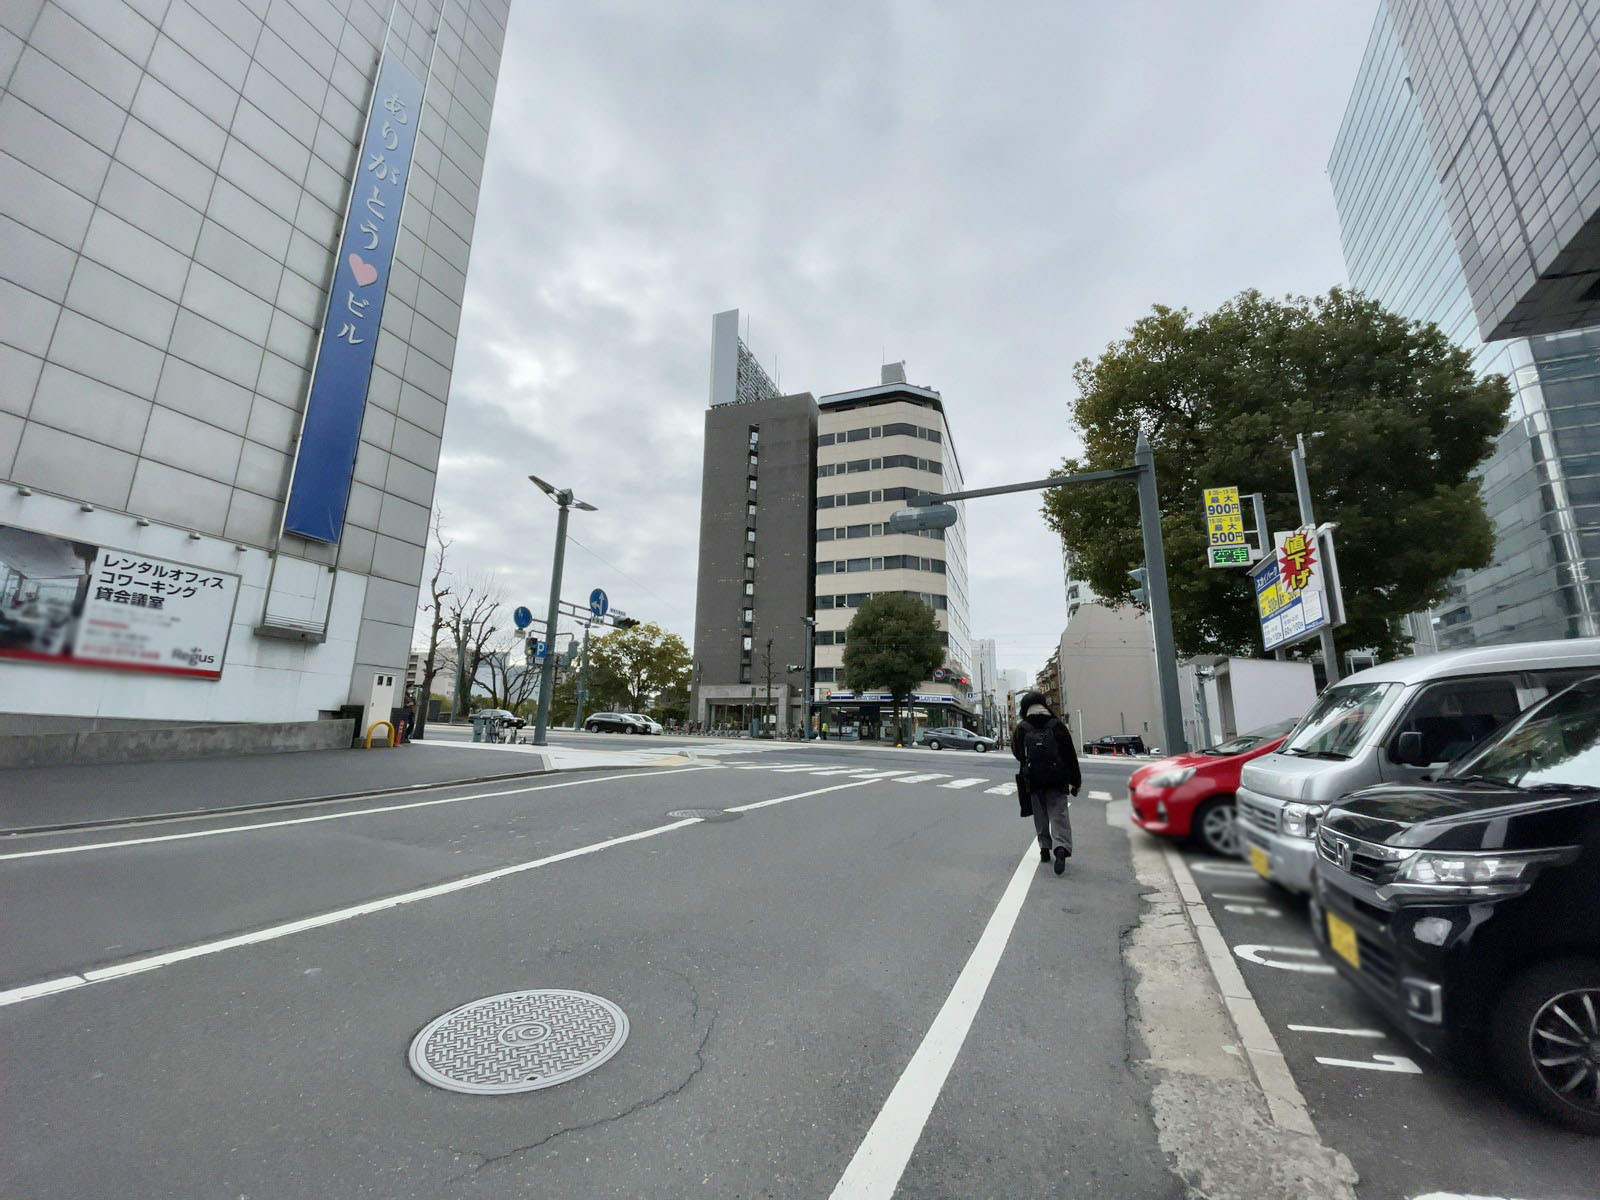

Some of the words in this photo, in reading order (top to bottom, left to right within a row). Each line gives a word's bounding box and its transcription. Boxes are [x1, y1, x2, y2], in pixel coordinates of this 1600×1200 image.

[360, 93, 408, 251] ありがとう
[337, 290, 369, 345] ビル
[1207, 503, 1240, 515] 900円
[1211, 531, 1244, 543] 500円
[1213, 548, 1248, 564] 空車
[1284, 533, 1310, 590] 値下げ
[98, 570, 197, 599] コワーキング
[103, 554, 224, 590] レンタルオフィス
[95, 587, 165, 610] 貸会議室
[537, 642, 545, 655] P
